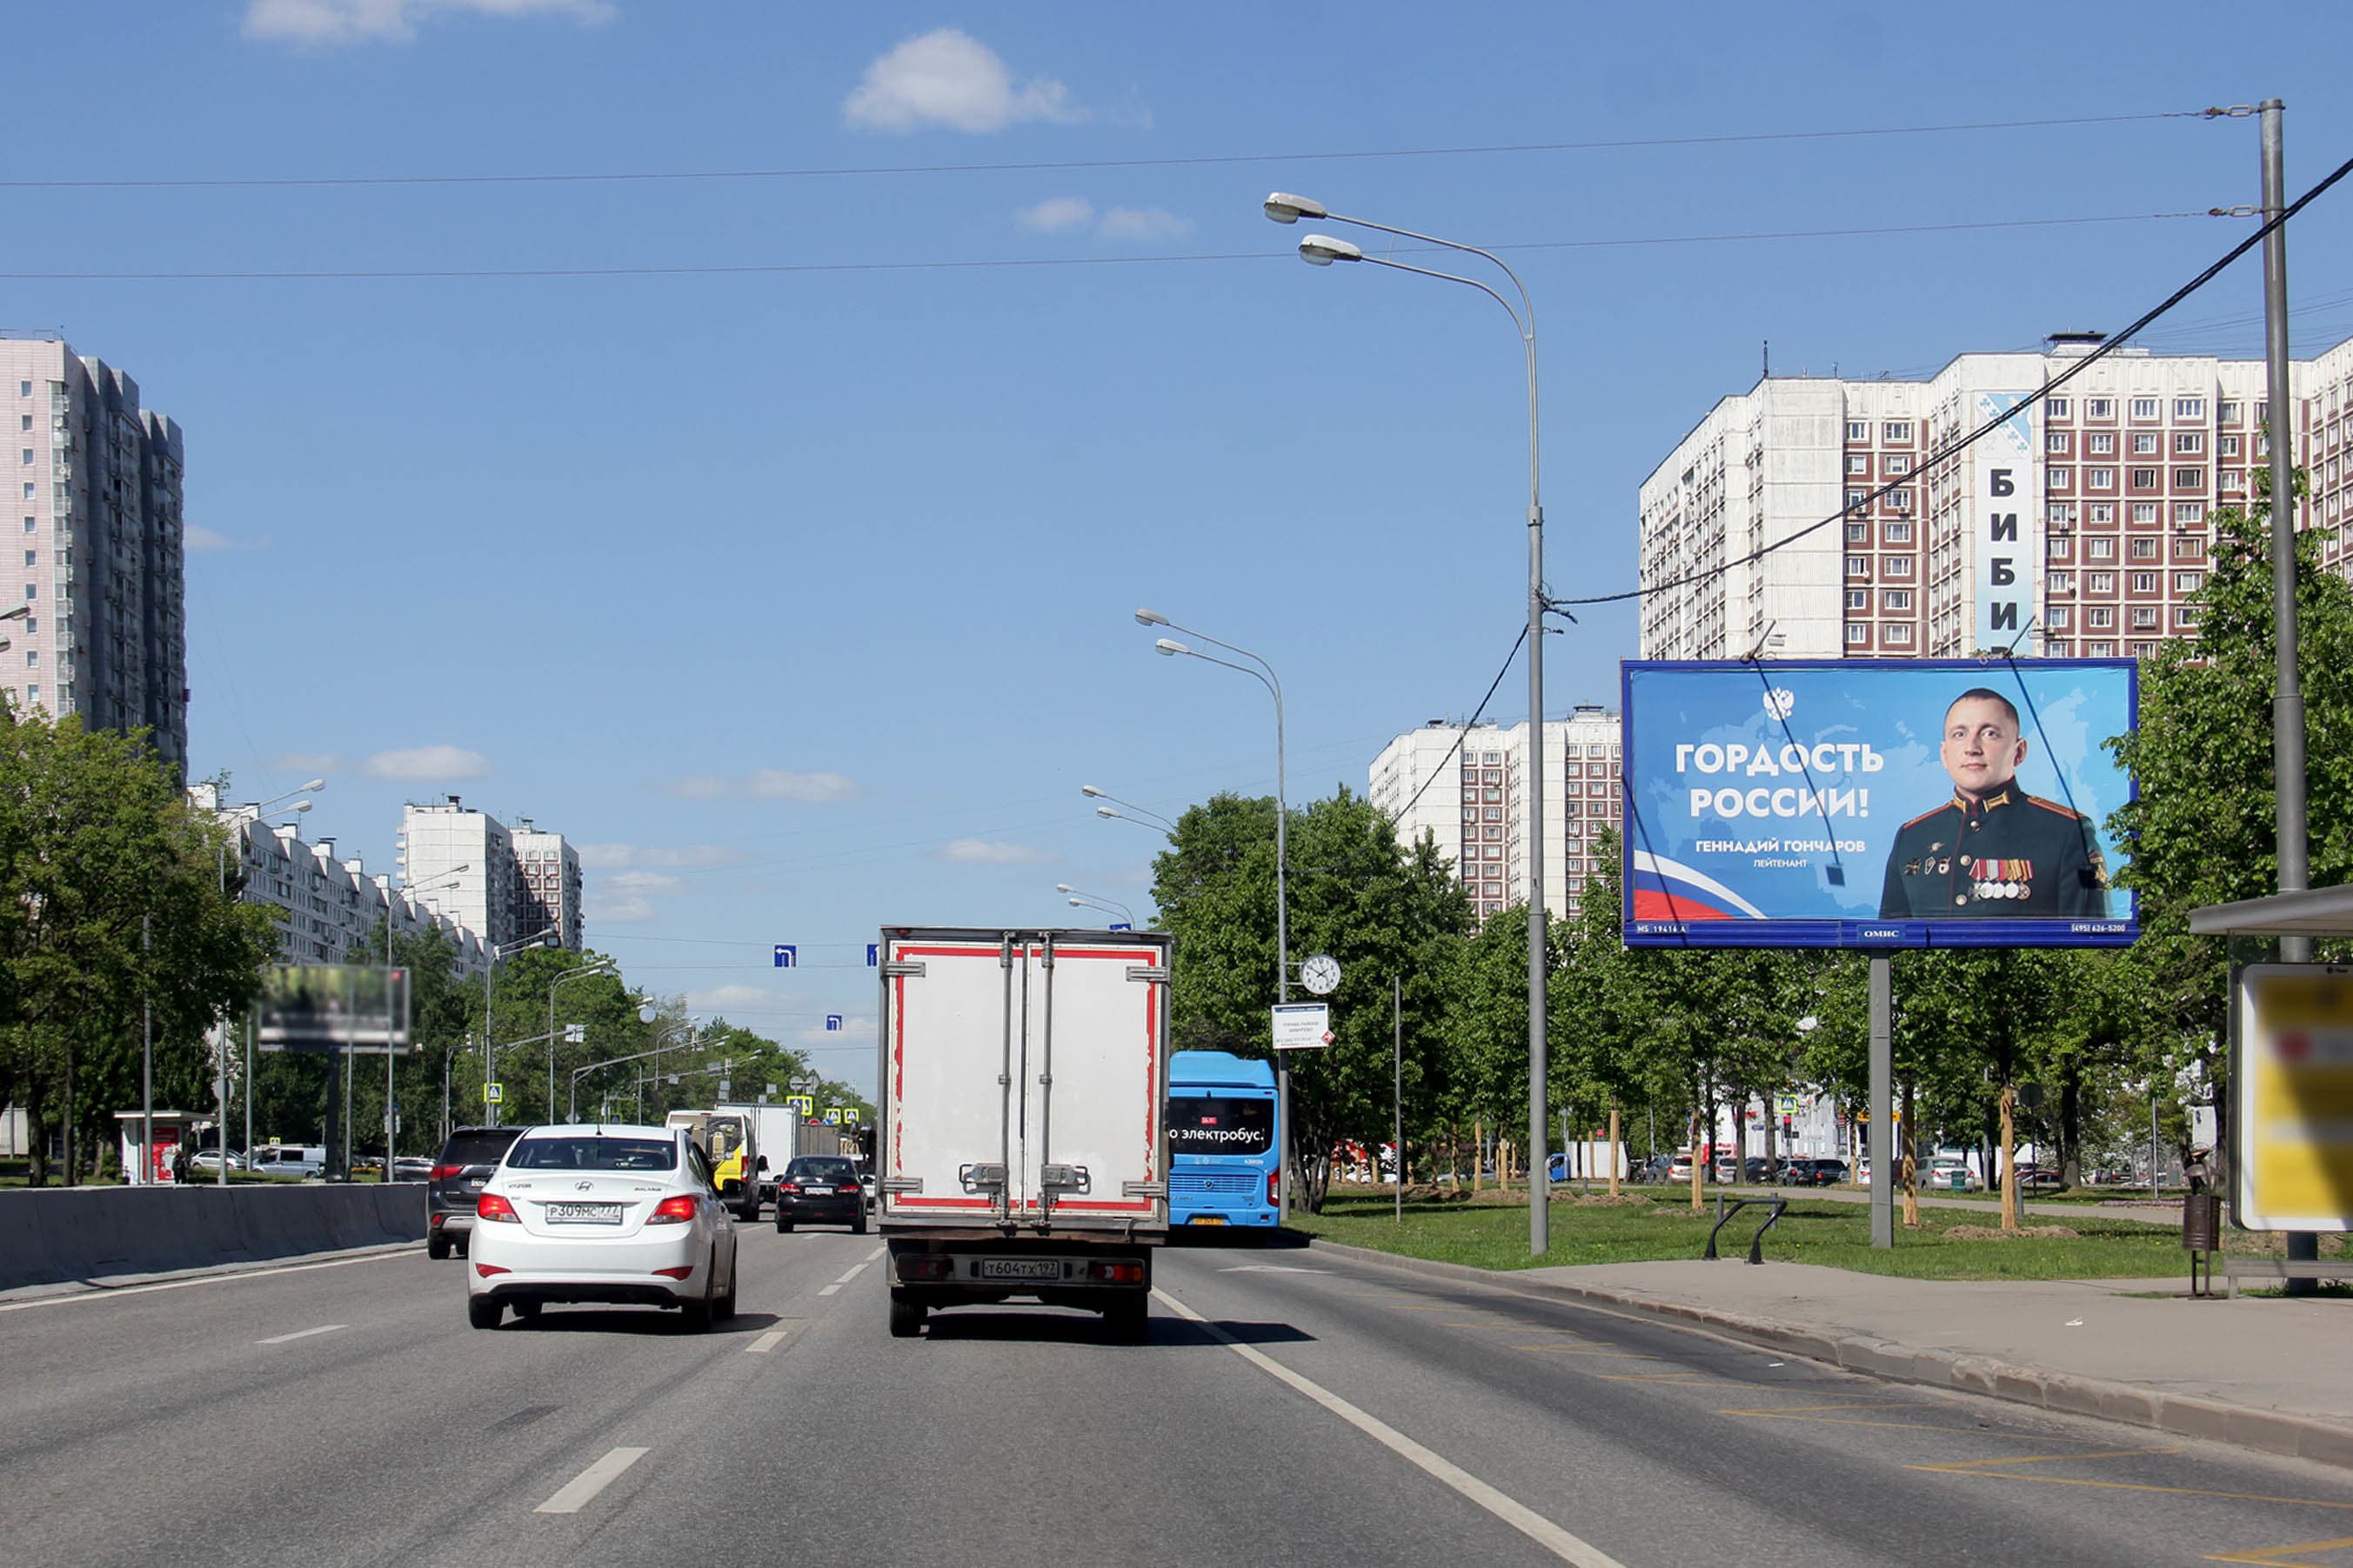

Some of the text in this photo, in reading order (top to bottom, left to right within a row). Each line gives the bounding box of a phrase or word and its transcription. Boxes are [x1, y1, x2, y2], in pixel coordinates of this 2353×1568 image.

[1989, 469, 2018, 655] БИБИ
[1675, 744, 1884, 777] ГОРДОСТЬ
[1690, 787, 1869, 817] РОССИИ!
[1696, 837, 1866, 853] ГЕННАДИЙ ГОНЧАРОВ
[1753, 857, 1808, 868] ЛЕЙТЕНАНТ
[1181, 1127, 1264, 1144] электробус.
